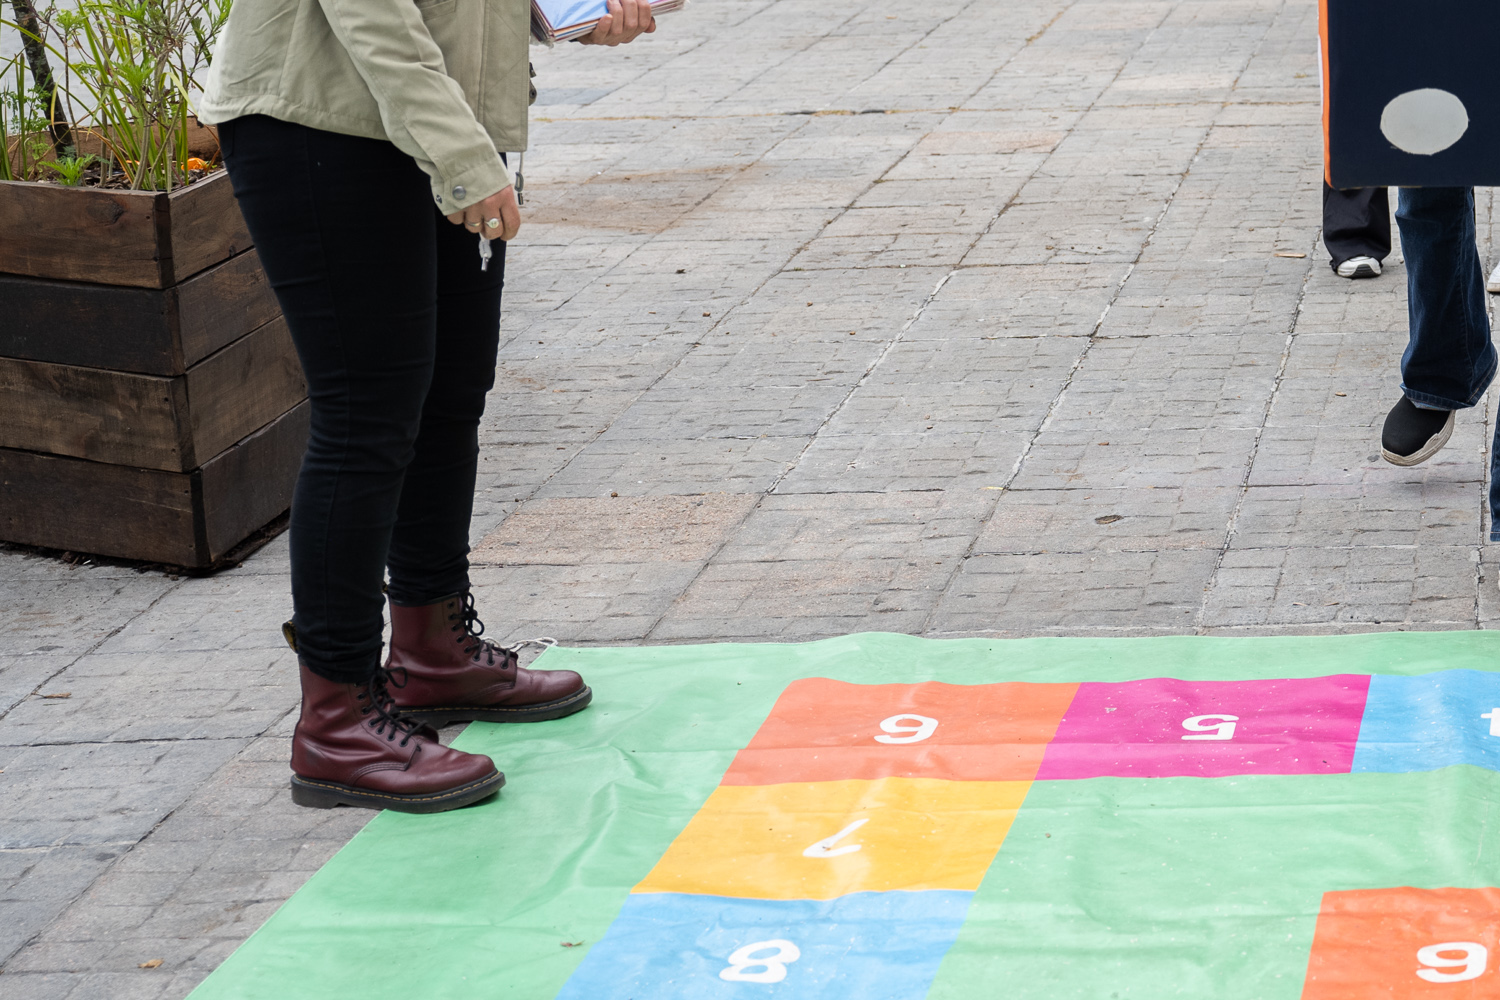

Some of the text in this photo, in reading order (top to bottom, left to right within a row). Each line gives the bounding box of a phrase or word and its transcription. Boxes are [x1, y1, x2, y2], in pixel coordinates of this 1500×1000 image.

[873, 713, 939, 744] 6
[1181, 714, 1240, 741] 5
[802, 818, 870, 858] 7
[719, 939, 801, 983] 8
